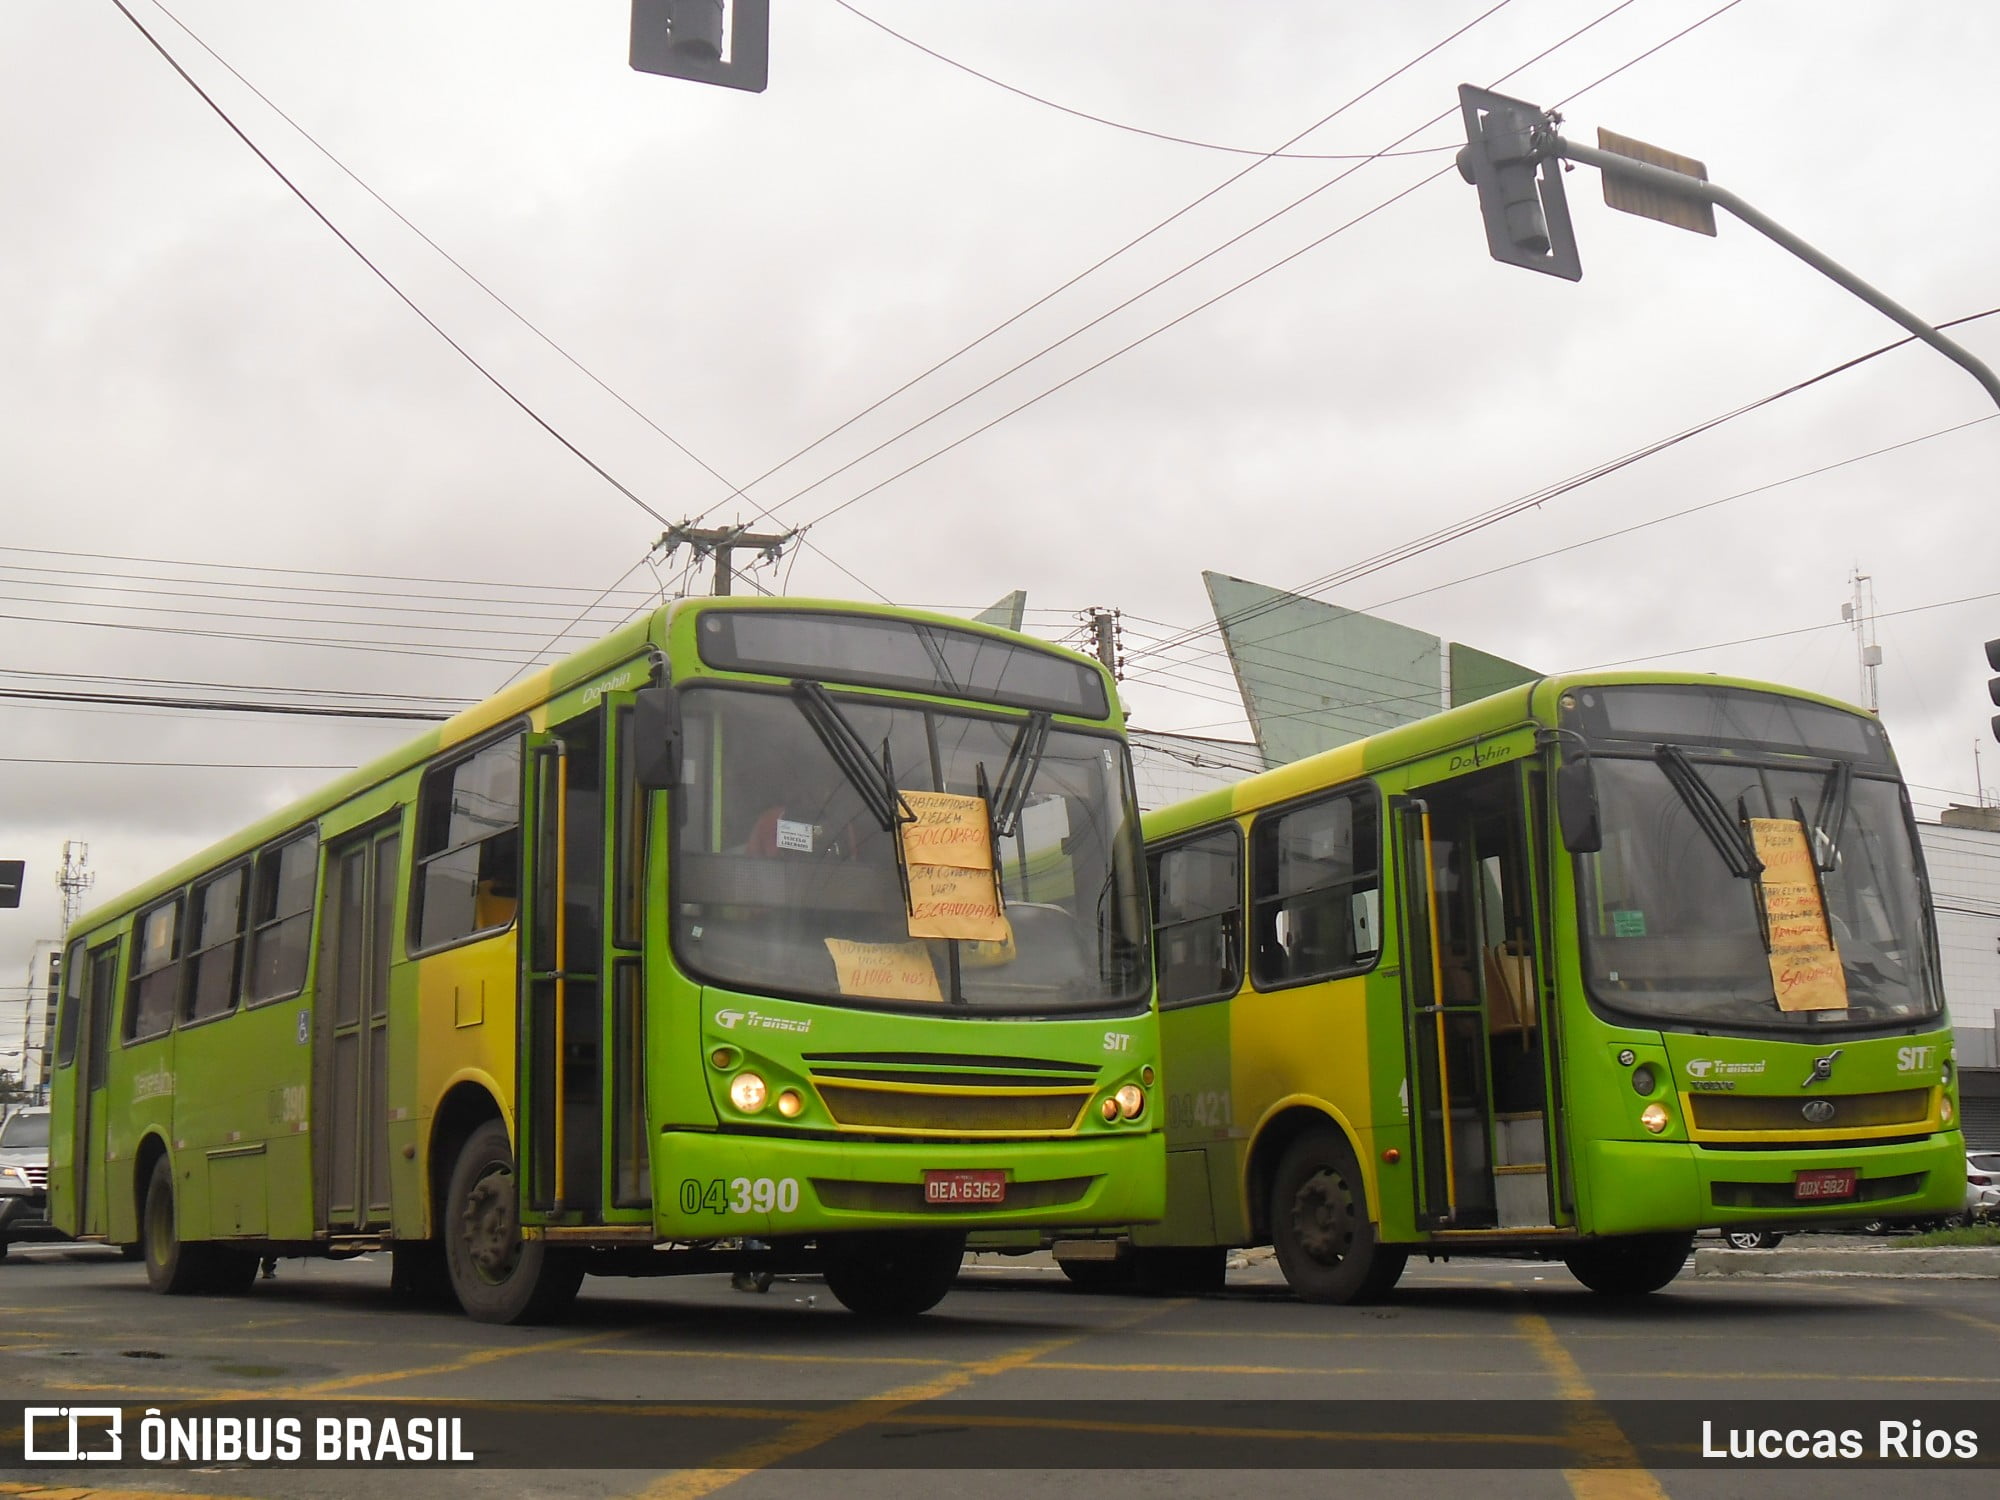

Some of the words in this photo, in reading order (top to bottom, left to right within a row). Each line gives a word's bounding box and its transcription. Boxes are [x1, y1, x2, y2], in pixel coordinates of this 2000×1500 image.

[1448, 746, 1511, 771] Dolphin
[747, 1010, 812, 1033] Transcol
[1713, 1059, 1766, 1074] Transcol
[679, 1177, 800, 1214] 04390
